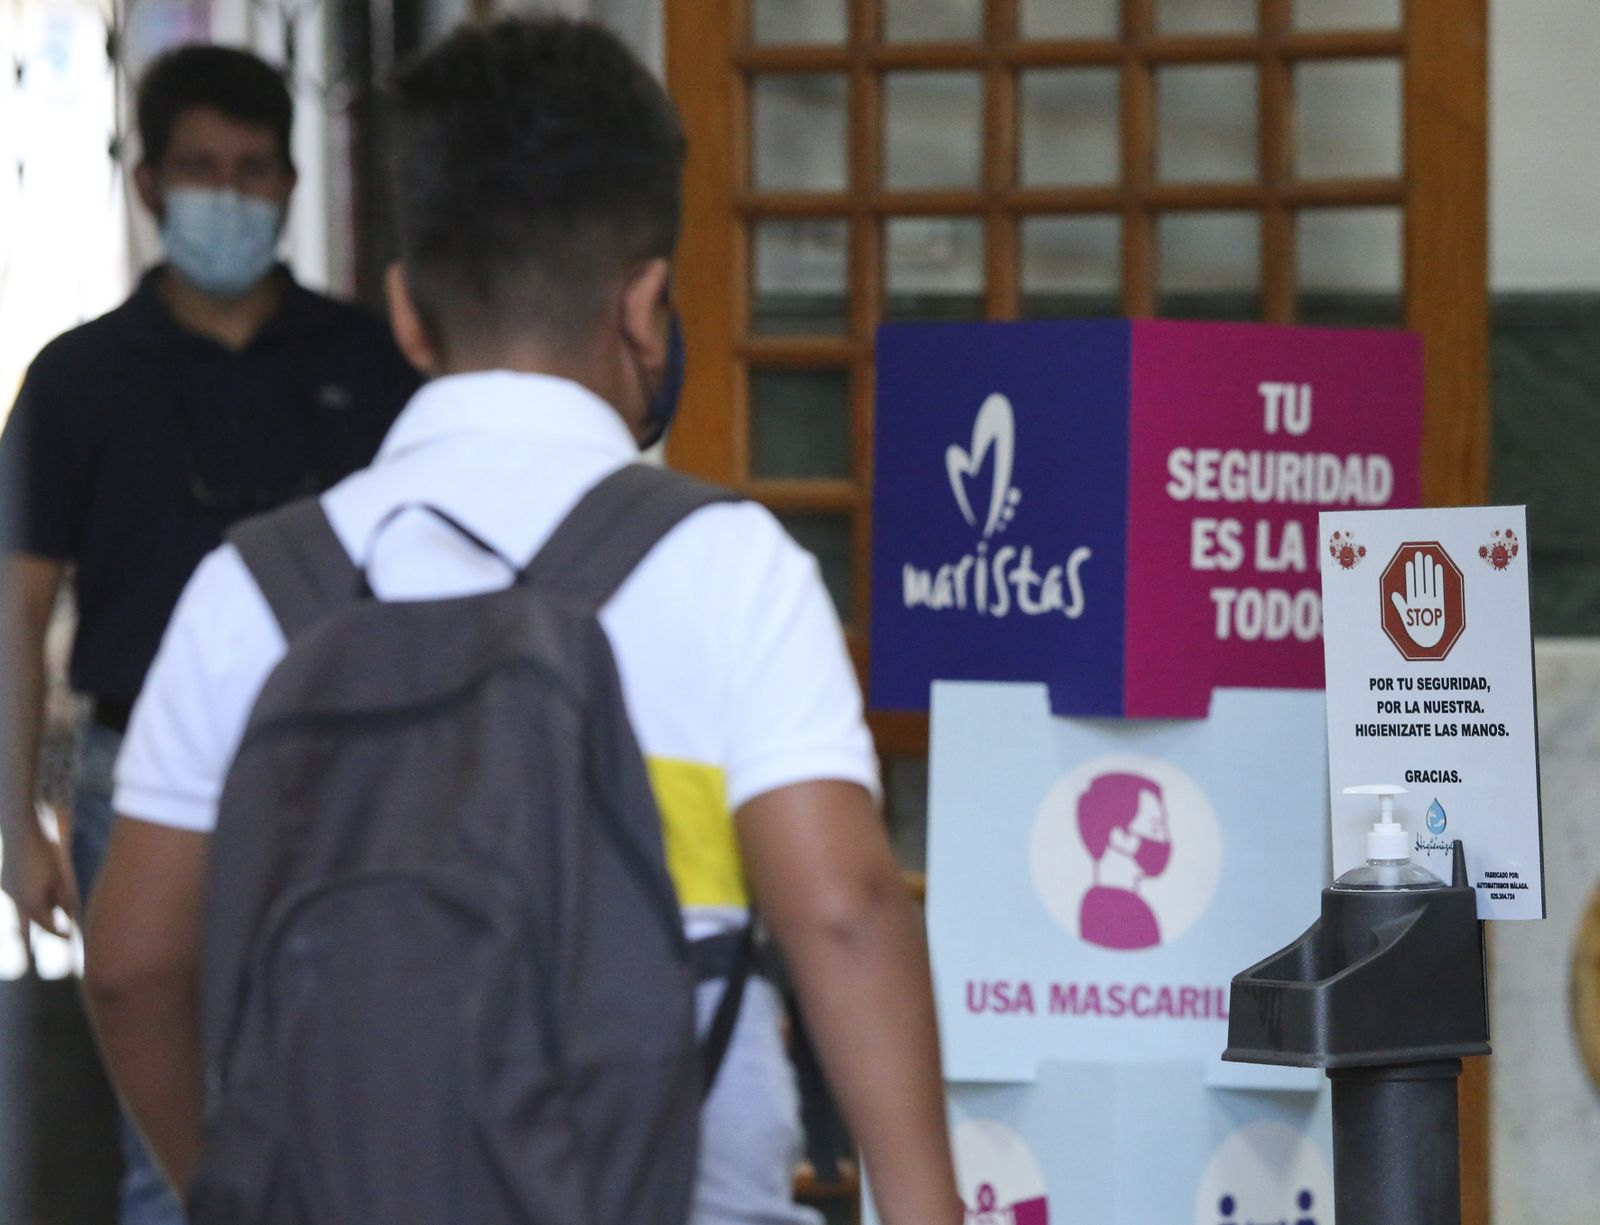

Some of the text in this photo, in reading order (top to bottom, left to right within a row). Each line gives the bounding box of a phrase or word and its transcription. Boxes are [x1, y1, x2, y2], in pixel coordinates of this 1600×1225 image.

[1259, 382, 1312, 435] TU
[1166, 448, 1393, 506] SEGURIDAD
[1191, 518, 1243, 570] ES
[1255, 521, 1307, 573] LA
[902, 543, 1092, 619] maristas
[1211, 588, 1324, 642] TODO
[1406, 607, 1443, 627] STOP
[1369, 677, 1491, 692] POR TU SEGURIDAD,
[1377, 700, 1485, 714] POR LA NUESTRA.
[1355, 724, 1510, 737] HIGIENIZATE LAS MANOS.
[1405, 770, 1462, 783] GRACIAS.
[965, 980, 1230, 1020] USA MASCARIL
